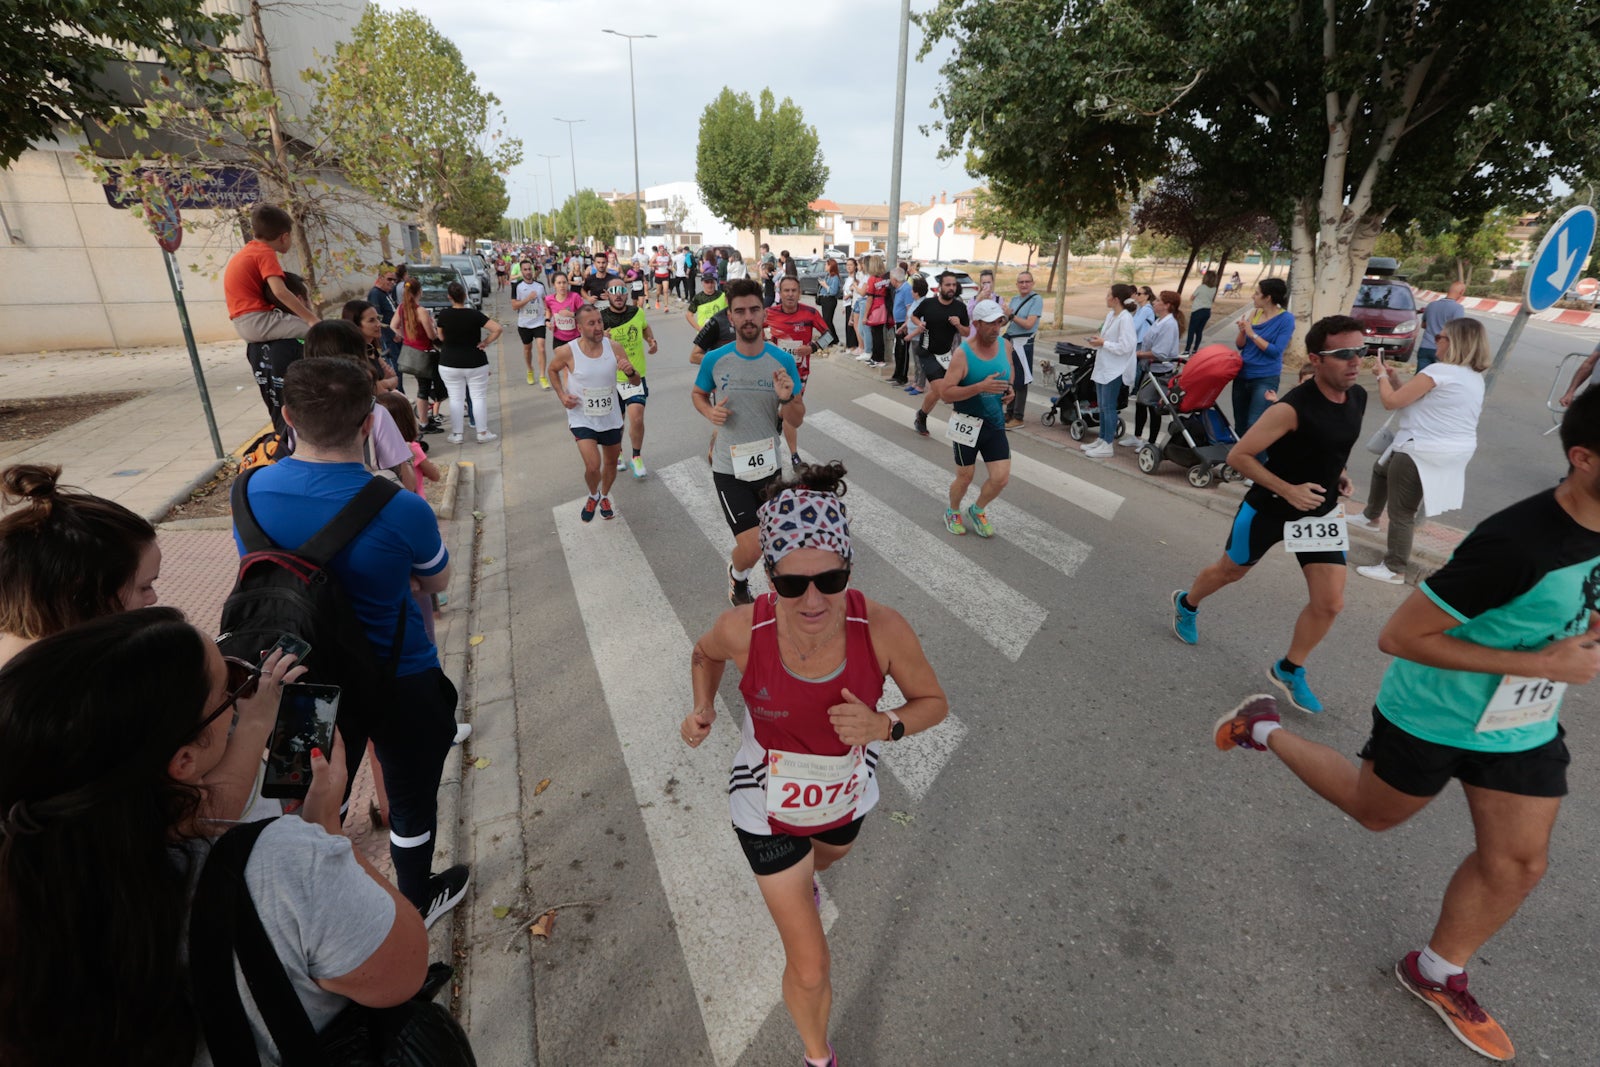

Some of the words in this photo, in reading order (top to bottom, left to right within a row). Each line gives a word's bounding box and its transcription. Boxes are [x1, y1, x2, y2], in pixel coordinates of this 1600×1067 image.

[211, 178, 226, 186] DE
[588, 397, 612, 408] 3139
[955, 421, 973, 435] 162
[748, 453, 765, 467] 46
[1291, 522, 1339, 538] 3138
